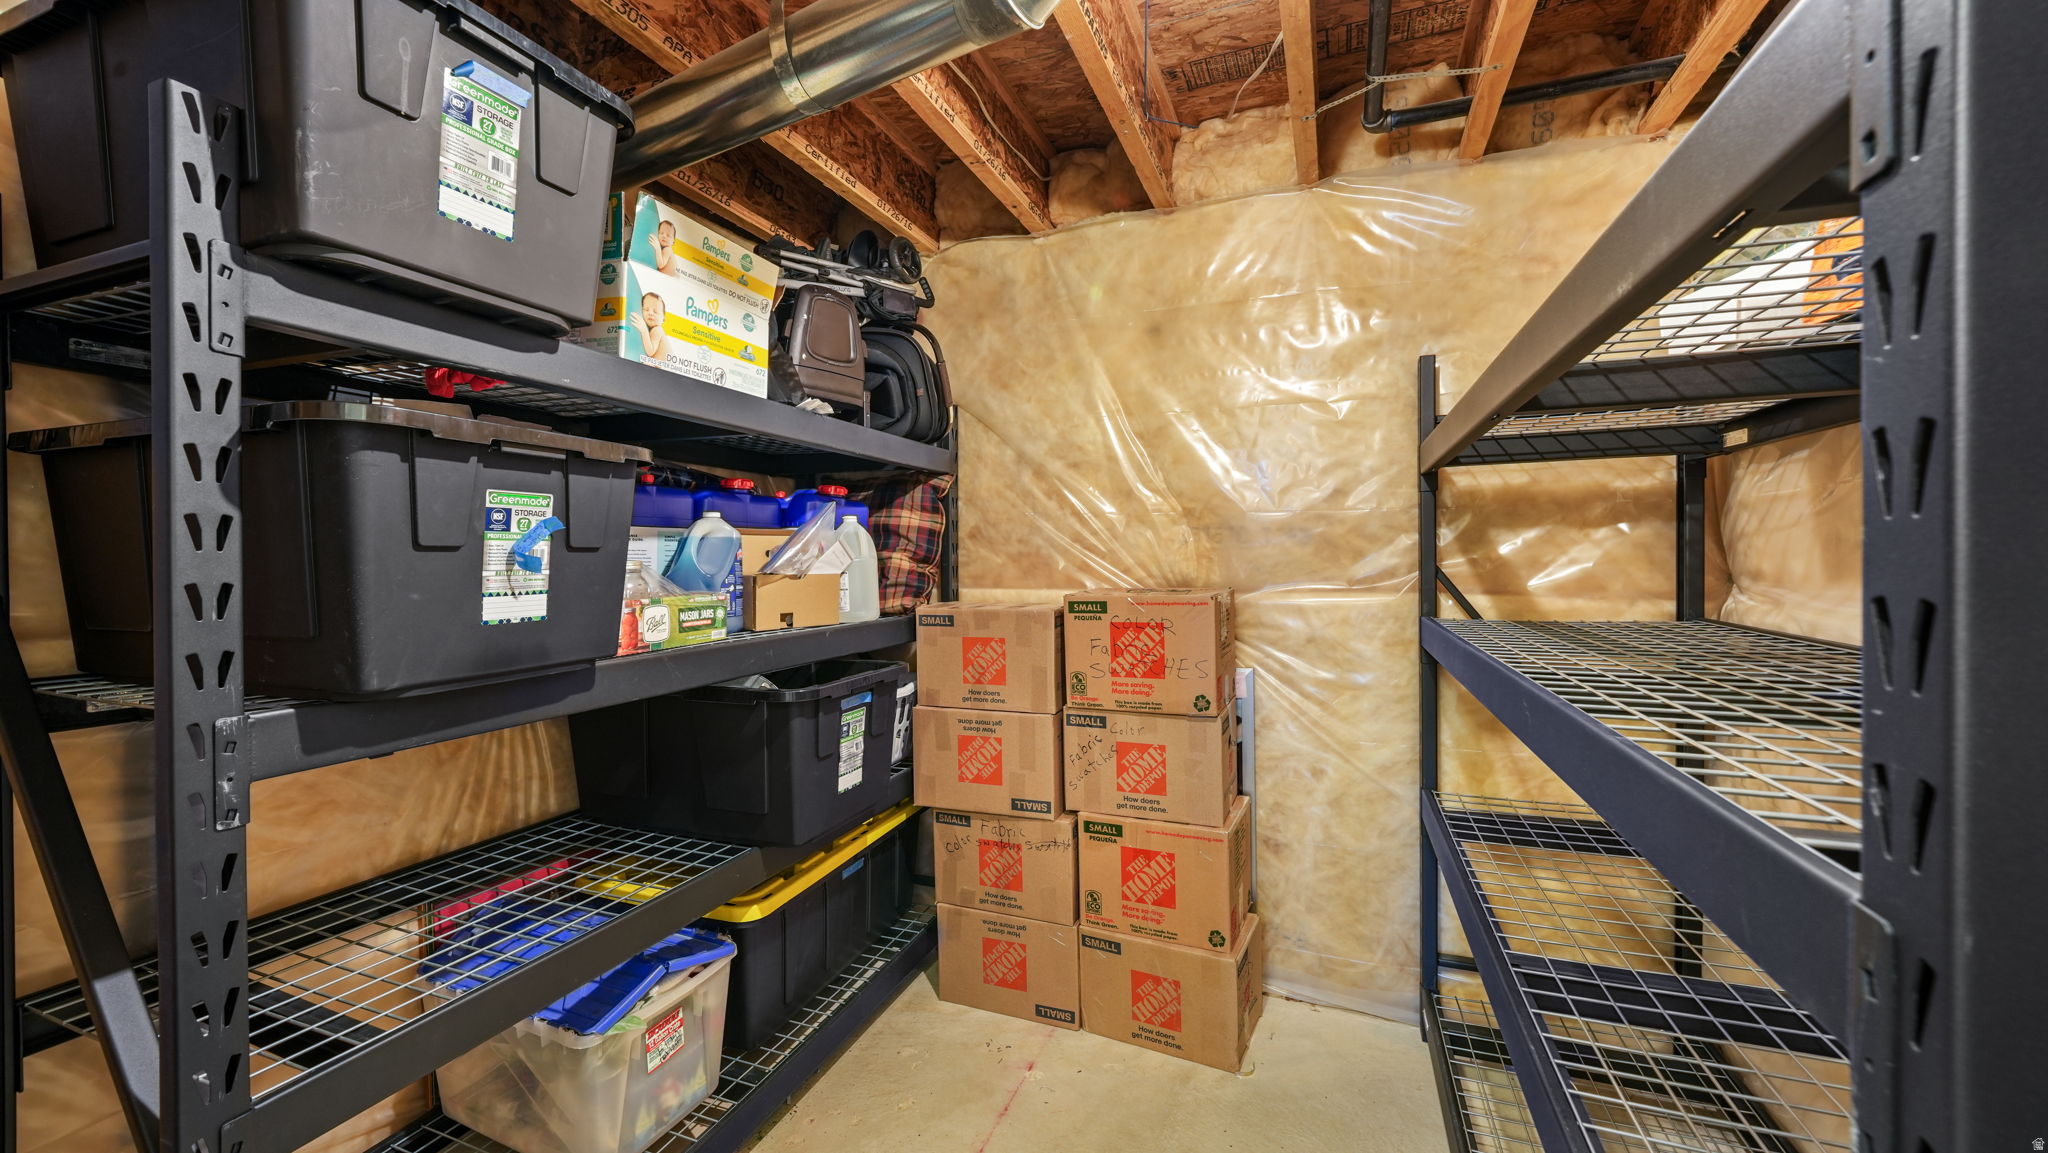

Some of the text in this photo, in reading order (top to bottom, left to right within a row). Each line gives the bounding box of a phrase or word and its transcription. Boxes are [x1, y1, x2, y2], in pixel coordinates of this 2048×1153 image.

[662, 36, 693, 64] APA
[450, 77, 516, 118] Greenmade
[452, 95, 466, 111] NSF
[476, 105, 514, 131] STORAGE
[444, 116, 486, 143] PROFESSIONAL
[482, 118, 494, 133] 27
[911, 74, 955, 123] ertified
[973, 139, 1007, 182] 01/26/16
[677, 170, 732, 207] 01/26/16
[804, 143, 856, 189] Certified
[876, 198, 913, 232] 01/26/16
[702, 236, 730, 262] Pampers
[728, 289, 737, 299] DO
[746, 298, 759, 308] FLUSH
[685, 296, 729, 330] Pampers
[607, 325, 618, 334] 672
[692, 326, 721, 343] Sensitive
[666, 353, 712, 374] DO NOT FLUSH
[755, 368, 766, 377] 672
[490, 493, 549, 507] Greenmade
[493, 512, 504, 521] NSF
[514, 509, 547, 517] STORAGE
[520, 519, 528, 528] 27
[1073, 603, 1102, 612] SMALL
[680, 609, 714, 621] MASON JARS
[922, 616, 951, 625] SMALL
[963, 638, 1006, 683] HOME
[1112, 680, 1155, 689] More saving.
[992, 719, 1003, 727] get
[1069, 716, 1103, 726] SMALL
[1109, 722, 1145, 736] Color
[1069, 734, 1103, 767] Fabric
[1117, 743, 1167, 792] HOME
[1135, 762, 1167, 794] DEPOT
[1014, 801, 1048, 812] SMALL
[1123, 795, 1161, 805] How doers
[1116, 802, 1128, 810] get
[1148, 806, 1169, 814] done.
[938, 814, 968, 825] SMALL
[980, 819, 1026, 838] Fabric
[1088, 824, 1118, 834] SMALL
[1089, 835, 1118, 844] PEQUEÑA
[1121, 851, 1175, 902] HOME
[1142, 872, 1176, 906] DEPOT
[979, 897, 990, 905] get
[990, 899, 1006, 908] more
[999, 894, 1017, 902] doers
[1086, 902, 1101, 910] ECO
[1122, 904, 1140, 913] More
[1122, 911, 1140, 920] More
[998, 922, 1015, 930] more
[1016, 924, 1027, 932] get
[1101, 922, 1119, 930] Green.
[987, 927, 1021, 939] How doers
[1084, 937, 1118, 952] SMALL
[1132, 979, 1181, 1022] HOME
[1038, 1007, 1072, 1020] SMALL
[1138, 1025, 1176, 1041] How doers
[1131, 1032, 1184, 1051] get more done.
